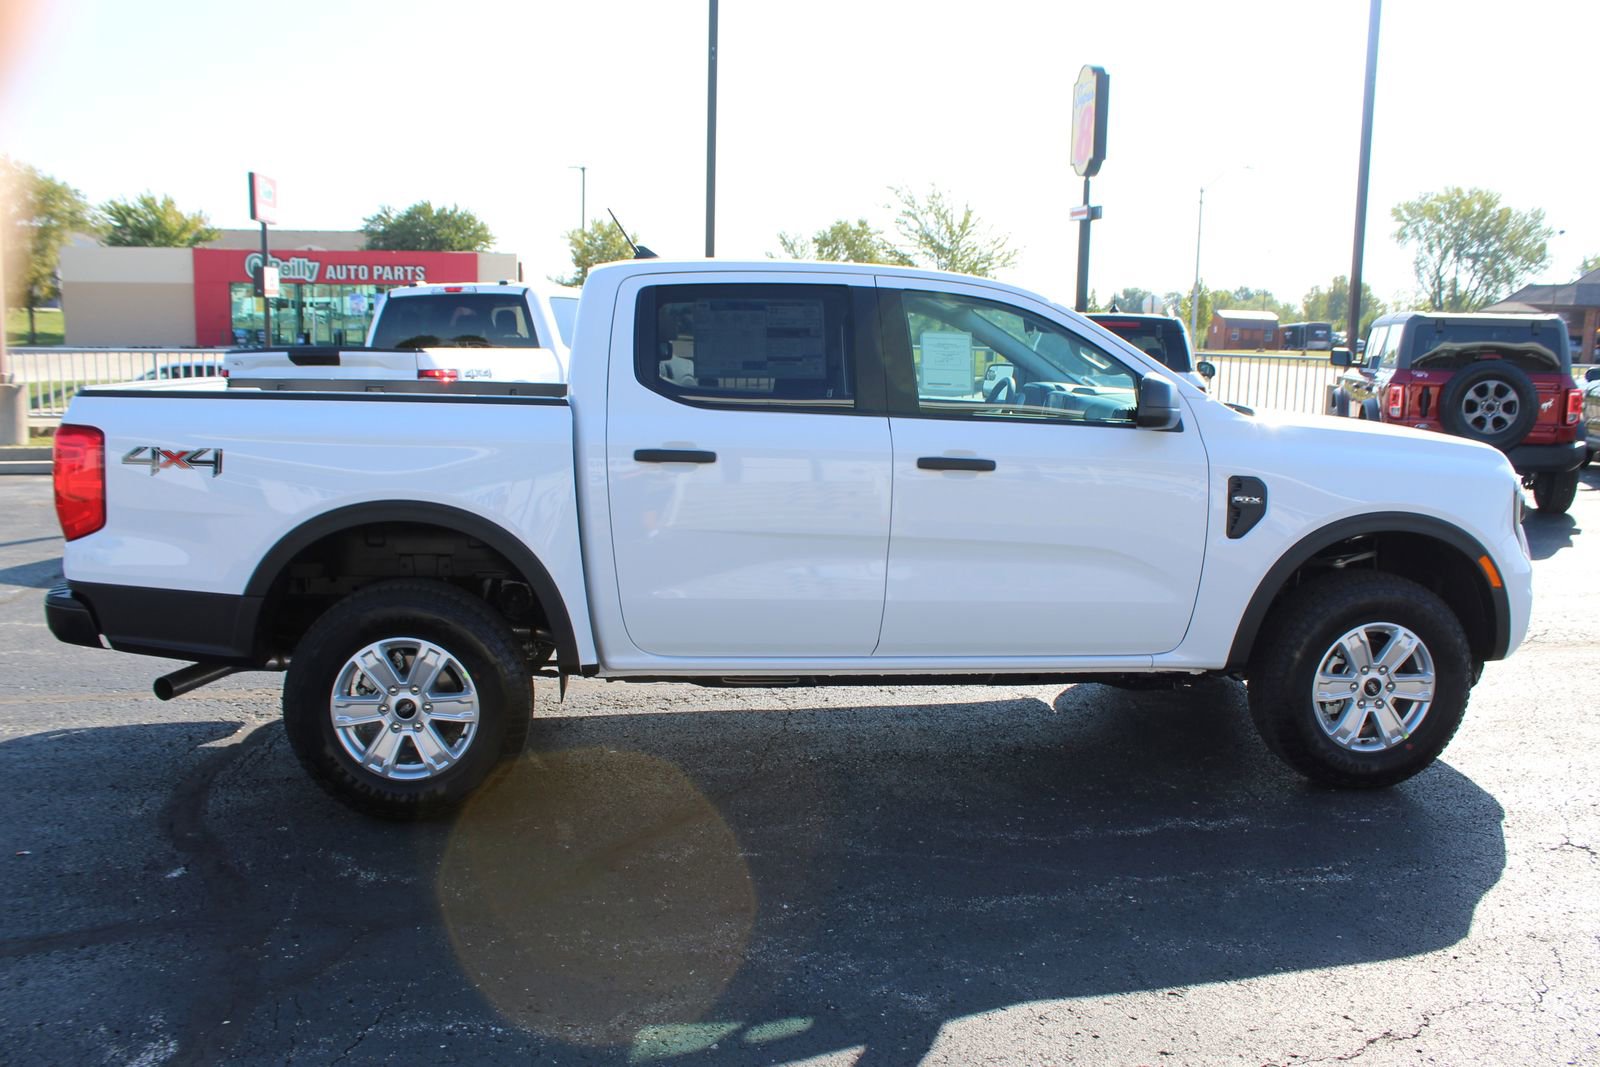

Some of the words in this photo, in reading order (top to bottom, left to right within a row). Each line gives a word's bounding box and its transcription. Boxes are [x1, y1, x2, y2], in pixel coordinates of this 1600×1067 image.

[245, 253, 320, 282] OReilly
[325, 264, 368, 280] AUTO
[373, 265, 426, 281] PARTS
[1233, 496, 1262, 504] STX
